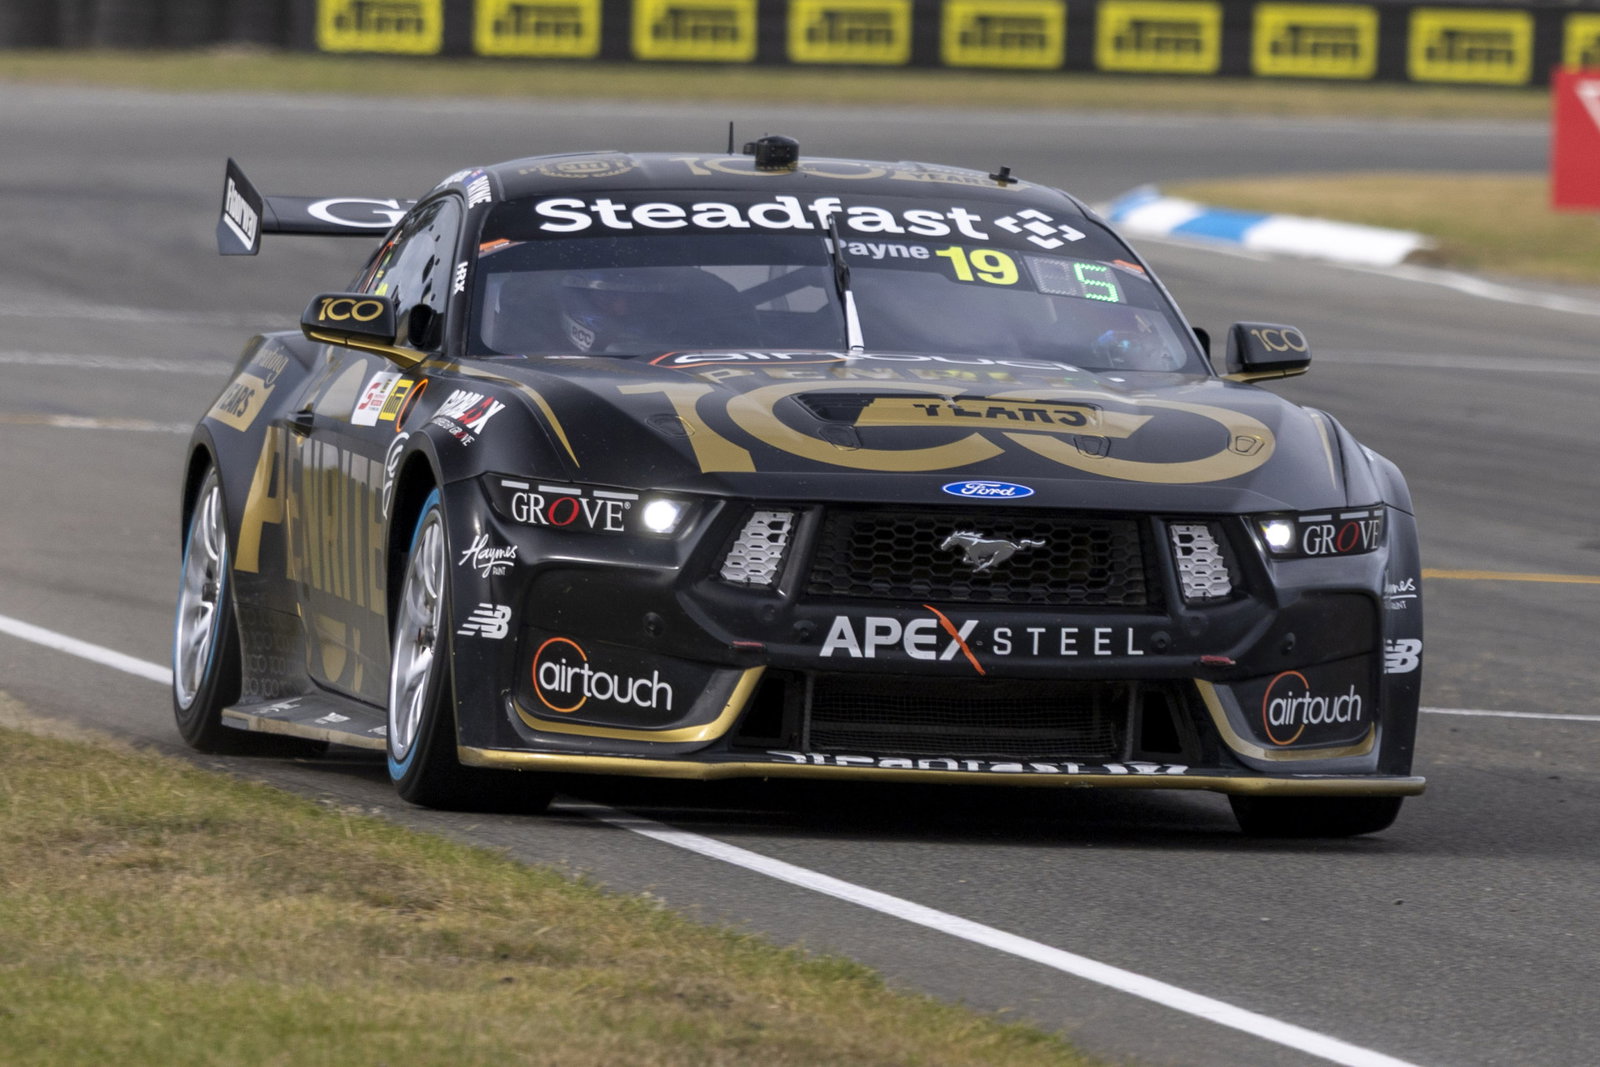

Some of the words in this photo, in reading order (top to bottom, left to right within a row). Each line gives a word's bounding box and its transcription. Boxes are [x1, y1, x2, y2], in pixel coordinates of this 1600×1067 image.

[534, 196, 990, 241] Steadfast
[824, 238, 931, 260] Payne
[936, 246, 1019, 286] 19
[961, 483, 1015, 497] Ford
[458, 533, 518, 578] Haymes
[1303, 520, 1379, 556] GROVE
[819, 604, 987, 676] APEX
[993, 627, 1145, 657] STEEL
[538, 658, 673, 712] airtouch
[1268, 684, 1362, 727] airtouch
